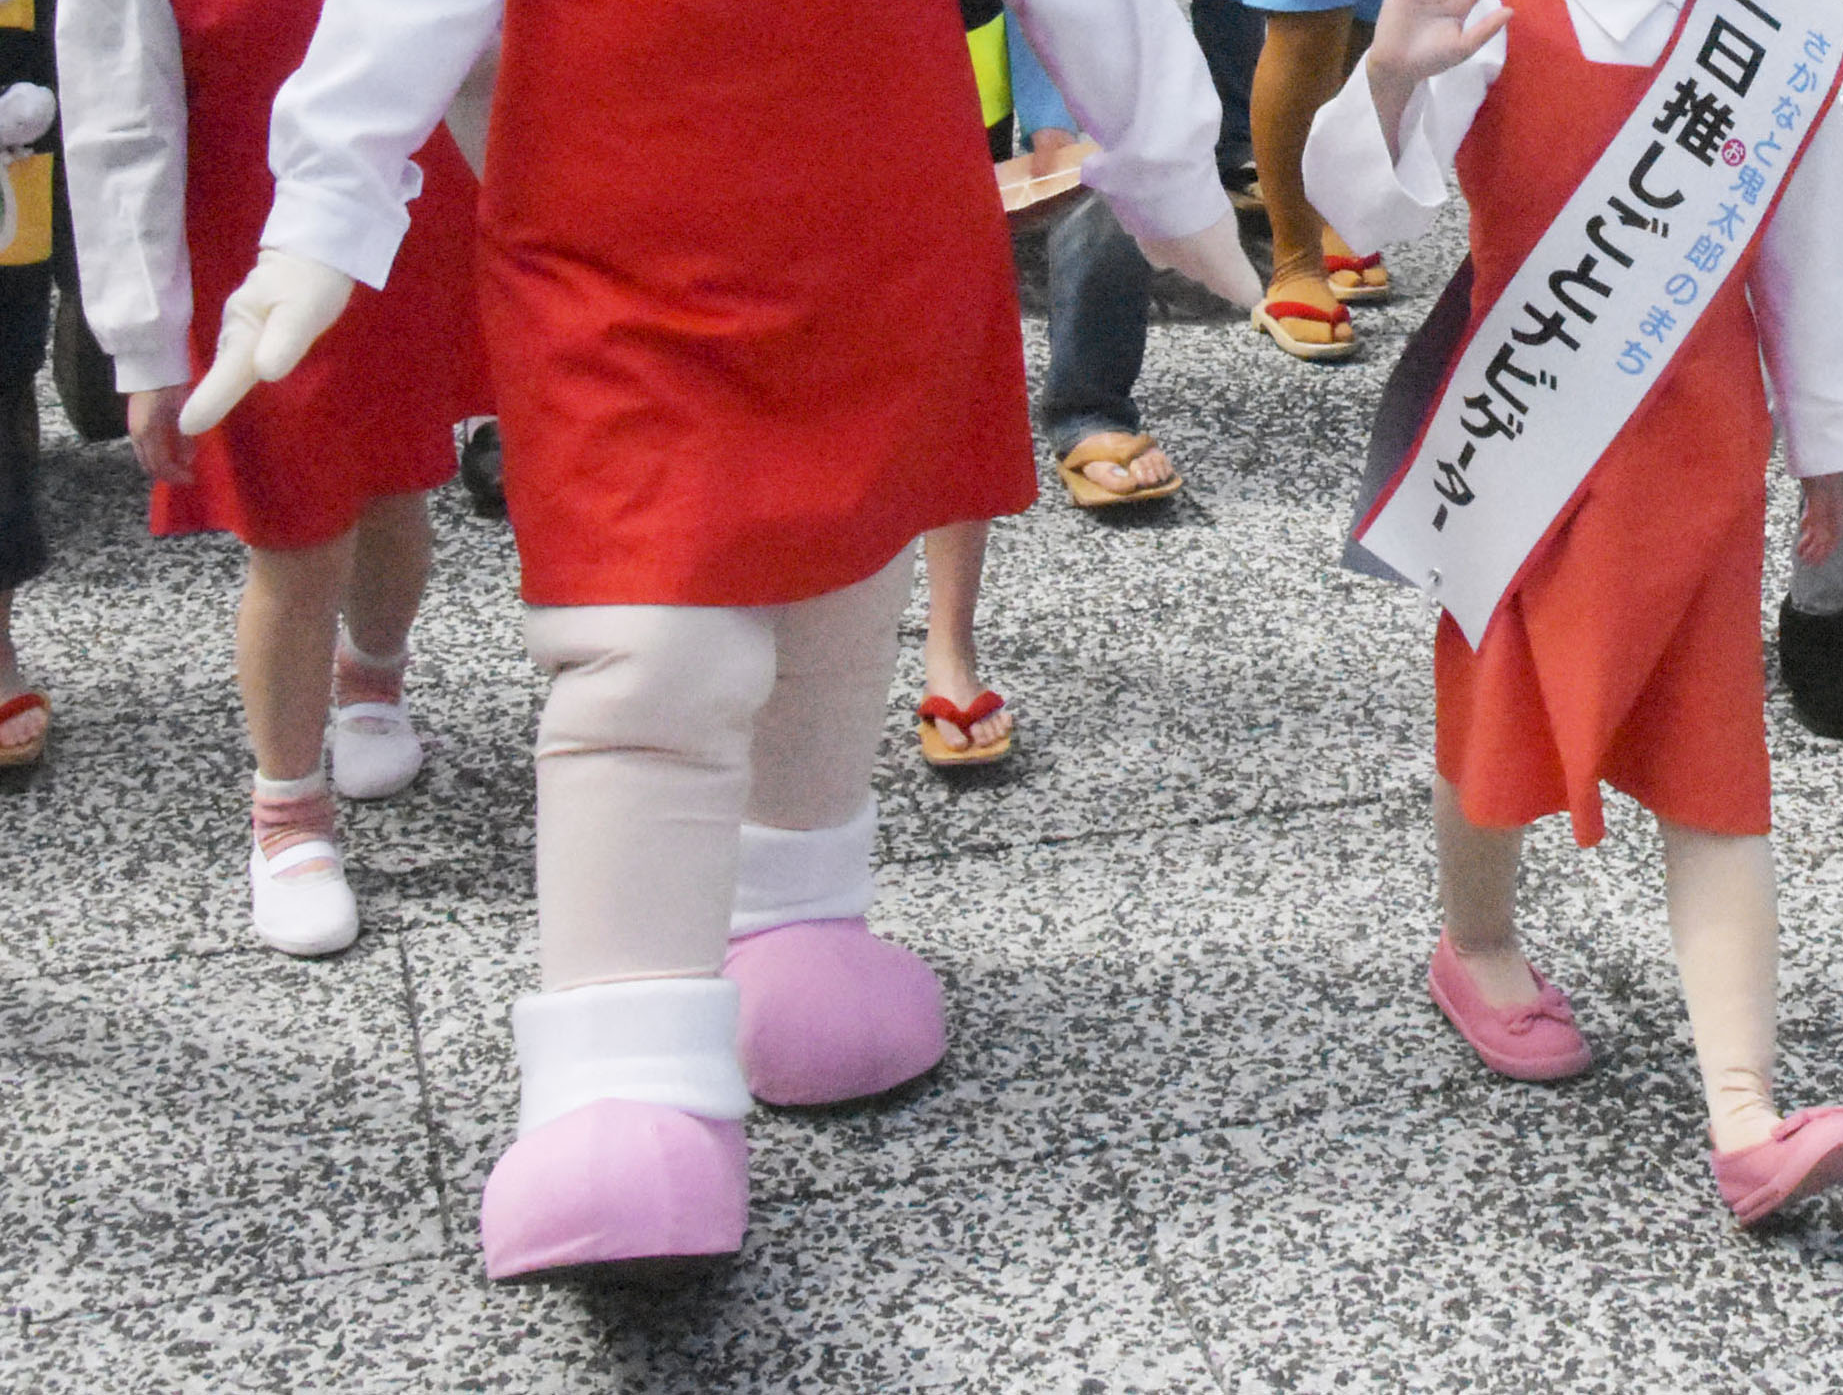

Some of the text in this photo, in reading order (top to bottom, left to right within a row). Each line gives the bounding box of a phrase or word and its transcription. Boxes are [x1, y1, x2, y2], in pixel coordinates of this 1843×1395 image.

[1616, 29, 1831, 376] さかなと鬼太郎のまち
